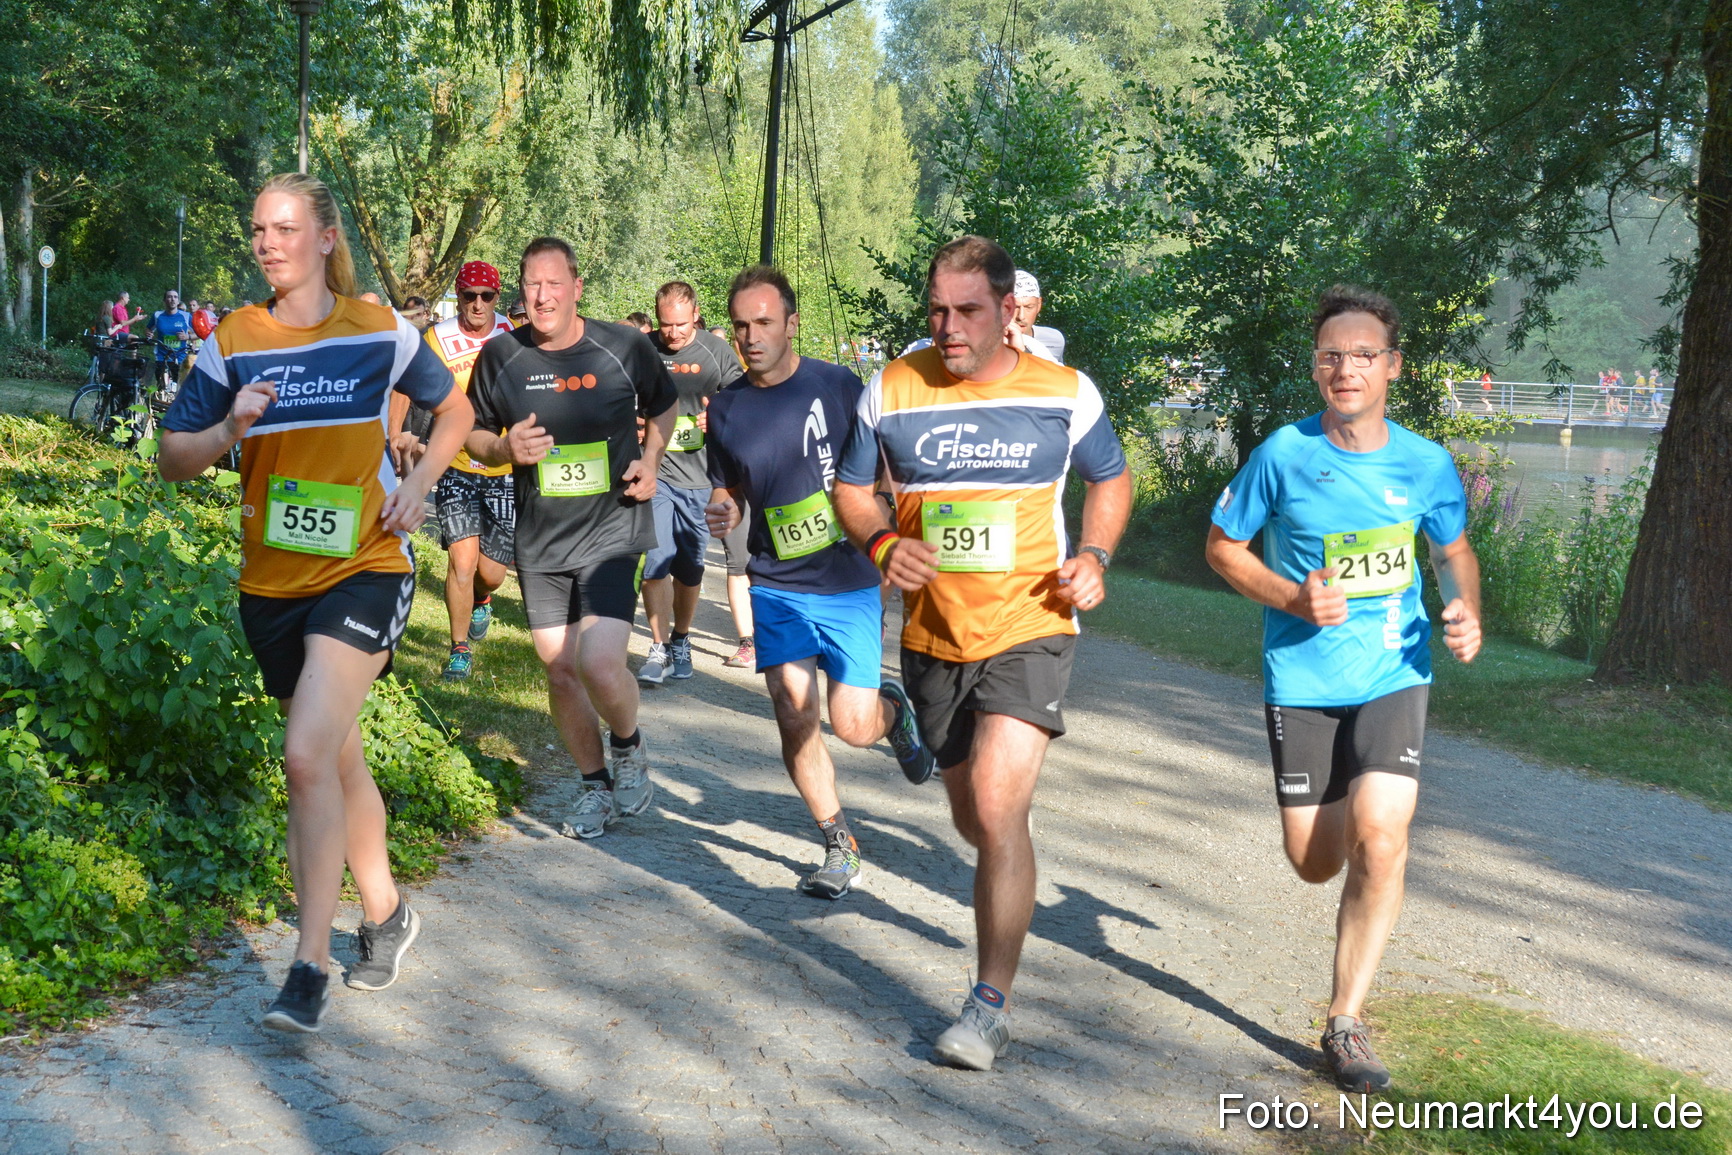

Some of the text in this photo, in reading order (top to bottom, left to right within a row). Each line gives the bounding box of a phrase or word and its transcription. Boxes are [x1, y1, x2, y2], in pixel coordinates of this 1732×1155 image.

[448, 358, 477, 374] MA
[529, 373, 555, 382] APTIV
[275, 394, 353, 408] AUTOMOBILE
[936, 438, 1038, 460] Fischer
[560, 463, 586, 482] 33
[946, 459, 1030, 470] AUTOMOBILE
[282, 504, 337, 535] 555
[778, 512, 828, 544] 1615
[288, 531, 328, 543] Mall Nicole
[942, 527, 990, 551] 591
[1338, 547, 1407, 580] 2134
[343, 616, 380, 639] hummel
